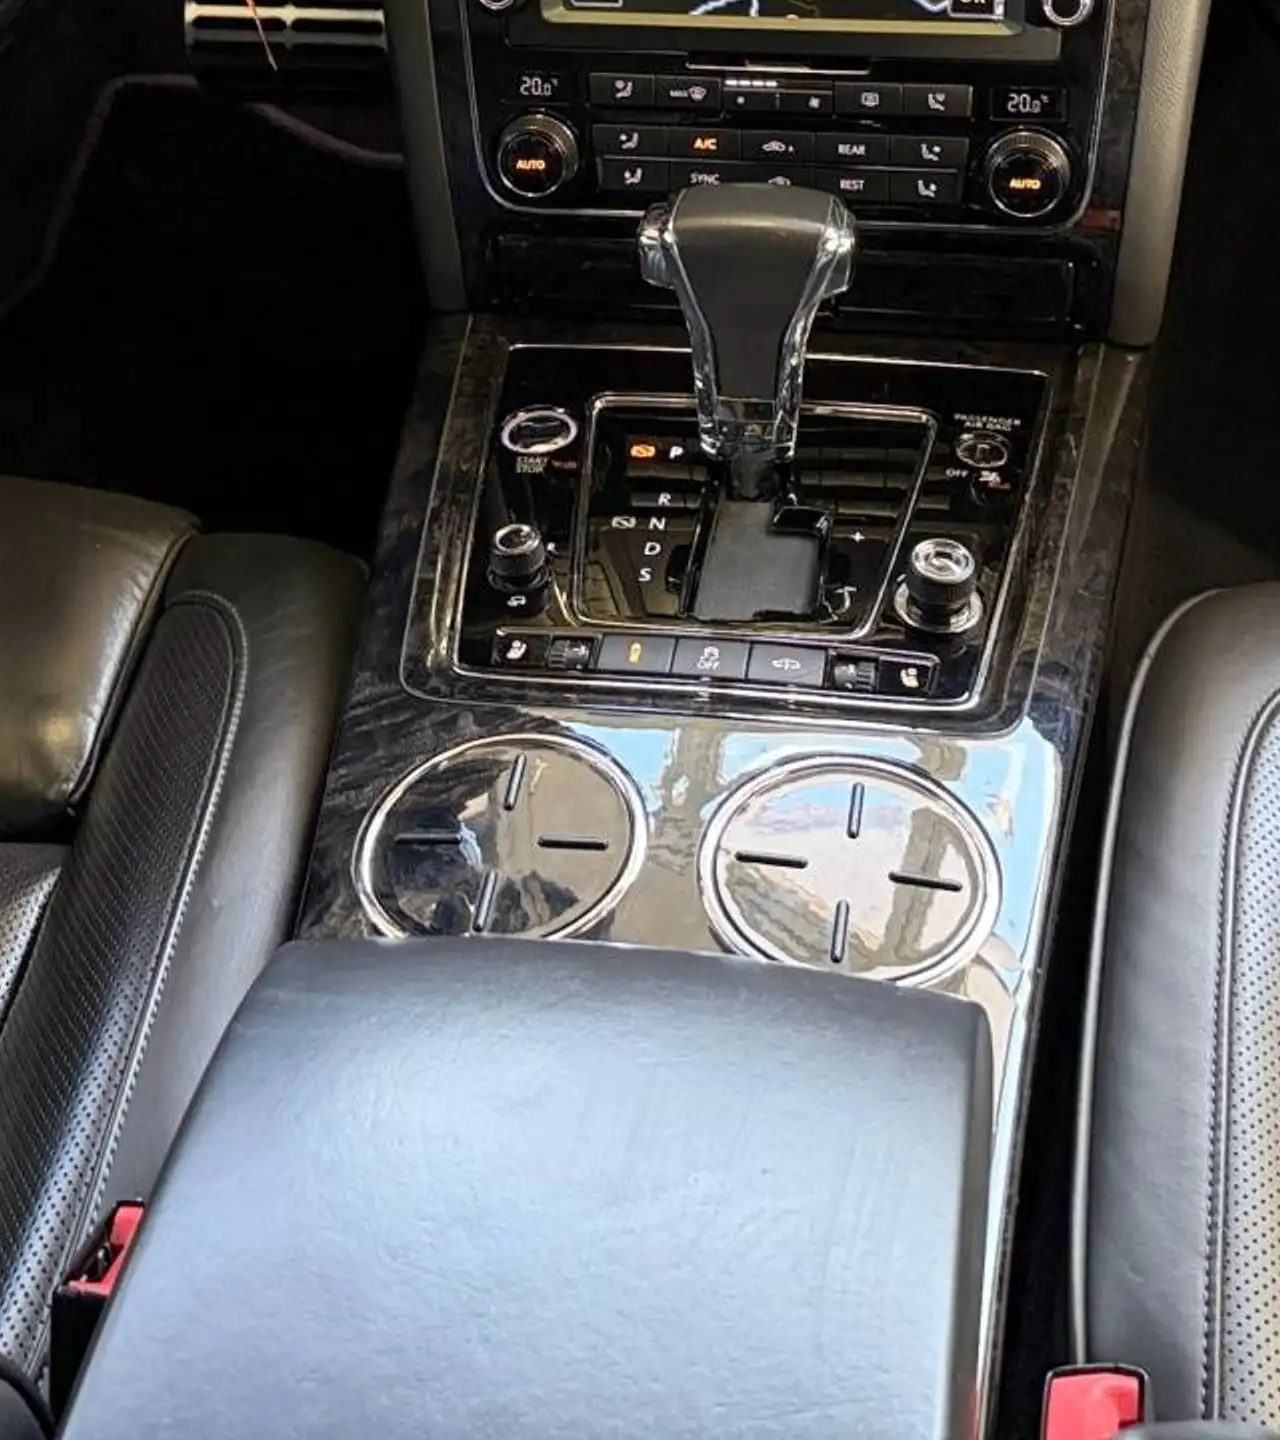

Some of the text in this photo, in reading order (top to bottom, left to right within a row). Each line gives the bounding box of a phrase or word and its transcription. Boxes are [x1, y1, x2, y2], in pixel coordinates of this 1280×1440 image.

[693, 138, 718, 150] A/C
[838, 144, 866, 156] REAR
[516, 159, 546, 170] AUTO
[690, 172, 720, 185] SYNC
[1009, 178, 1041, 190] AUTO
[840, 180, 864, 192] REST
[669, 446, 683, 459] P
[658, 492, 672, 507] R
[648, 516, 666, 530] N
[644, 541, 661, 556] D
[638, 567, 652, 581] S
